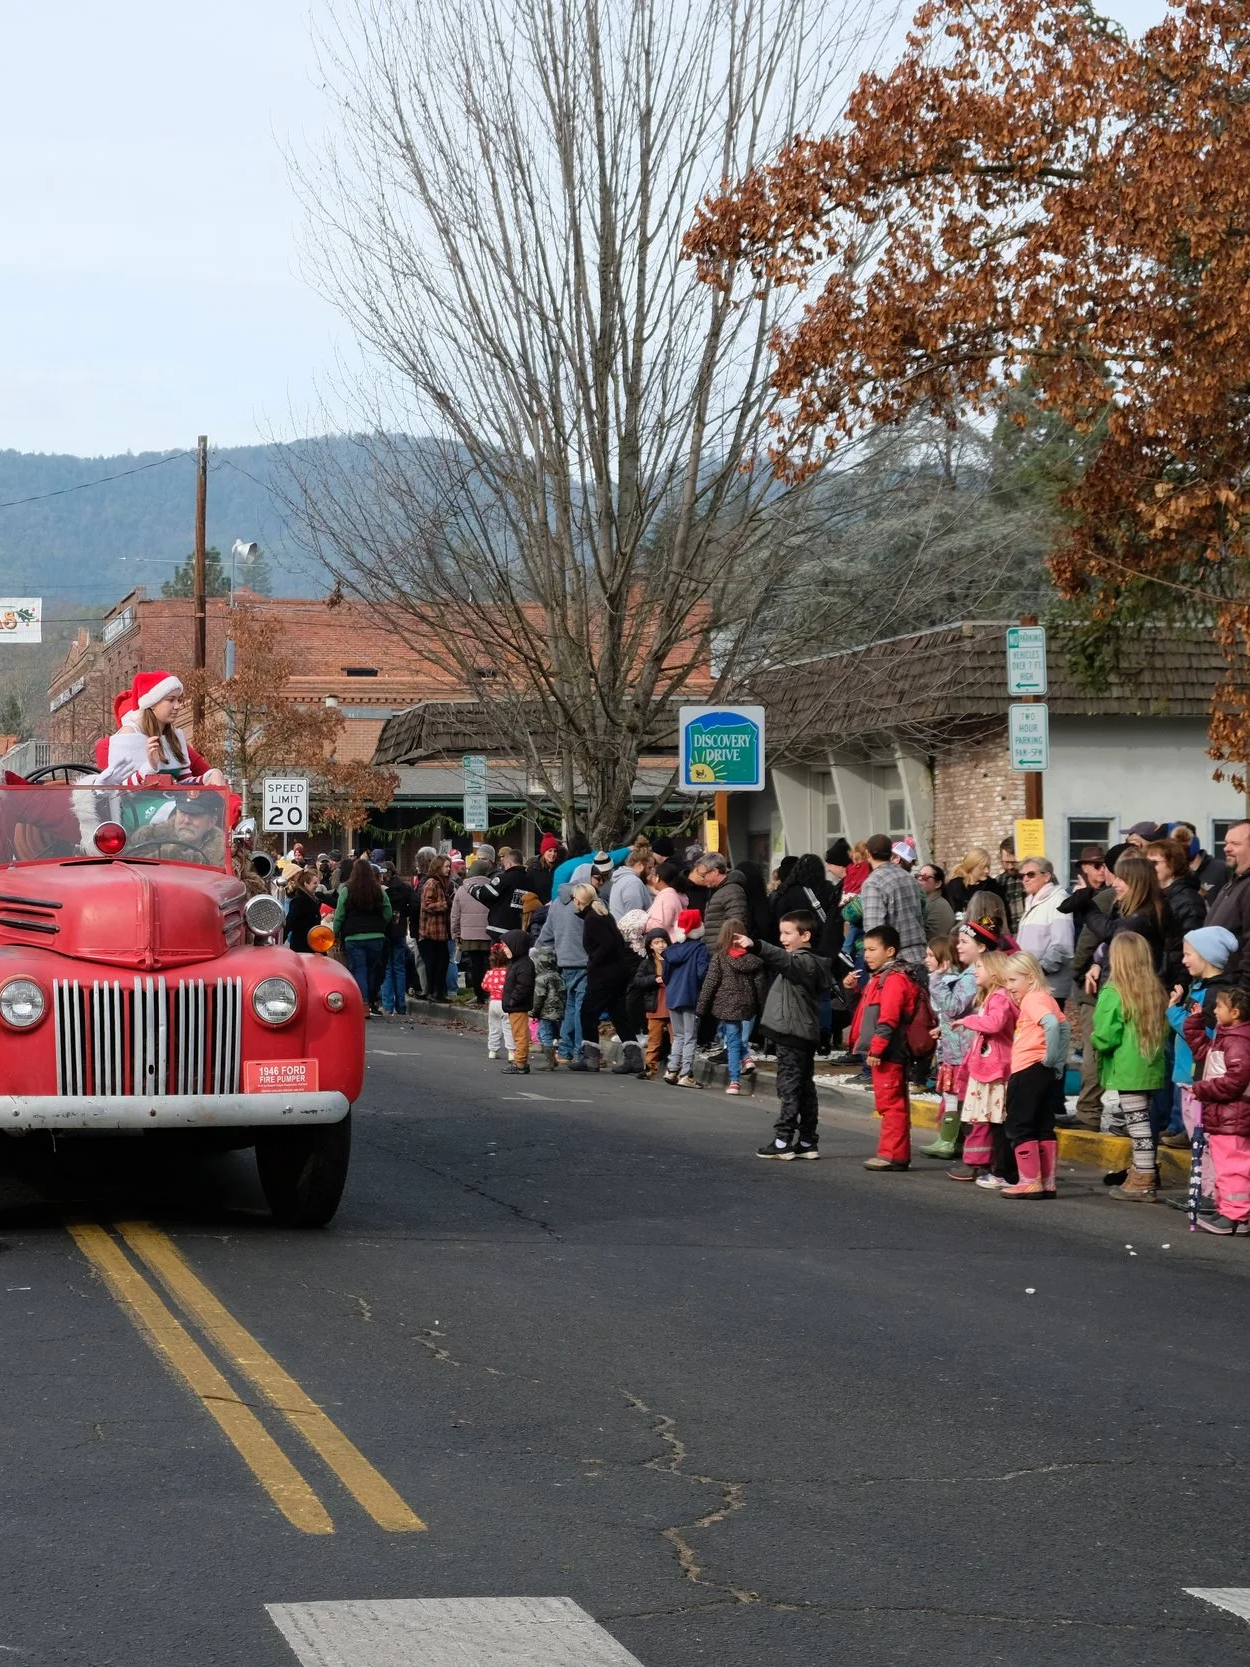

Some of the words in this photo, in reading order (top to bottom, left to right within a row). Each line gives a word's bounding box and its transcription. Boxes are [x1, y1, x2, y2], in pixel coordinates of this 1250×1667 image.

[1013, 650, 1040, 659] VEHICLES
[1012, 661, 1026, 670] OVER
[1021, 712, 1035, 721] TWO
[1019, 723, 1039, 733] HOUR
[694, 734, 751, 748] DISCOVERY
[1015, 736, 1043, 745] PARKING
[706, 749, 741, 761] DRIVE
[268, 784, 304, 793] SPEED
[271, 795, 300, 804] LIMIT
[268, 806, 303, 825] 20
[258, 1066, 279, 1076] 1946
[281, 1066, 306, 1075] FORD
[259, 1075, 276, 1084] FIRE
[277, 1075, 306, 1083] PUMPER
